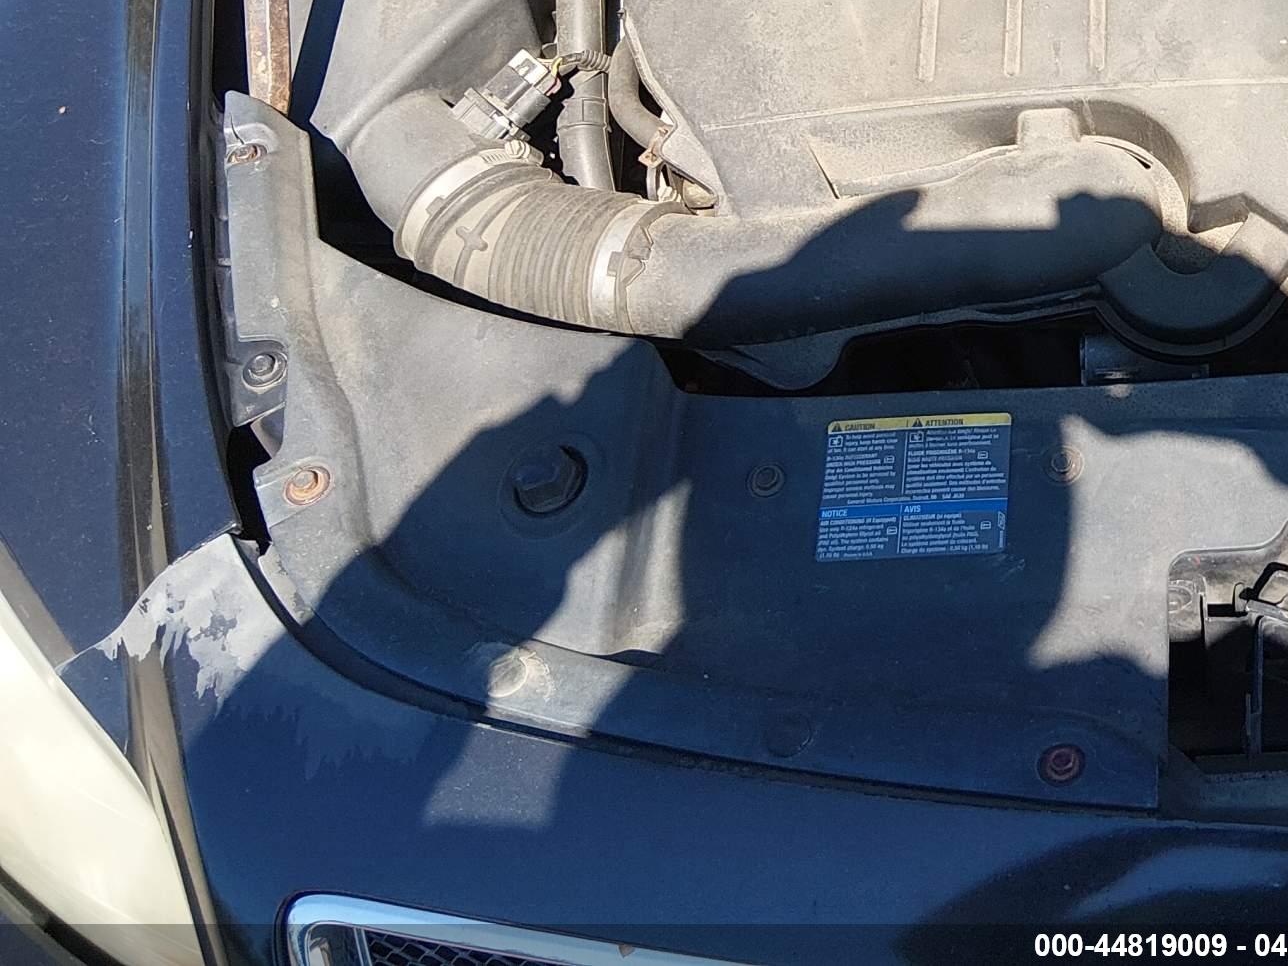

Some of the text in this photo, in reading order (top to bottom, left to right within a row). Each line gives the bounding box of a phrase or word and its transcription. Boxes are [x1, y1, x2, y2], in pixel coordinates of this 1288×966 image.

[844, 423, 875, 431] CAUTION
[904, 505, 921, 513] AVIS
[821, 509, 849, 518] NOTICE
